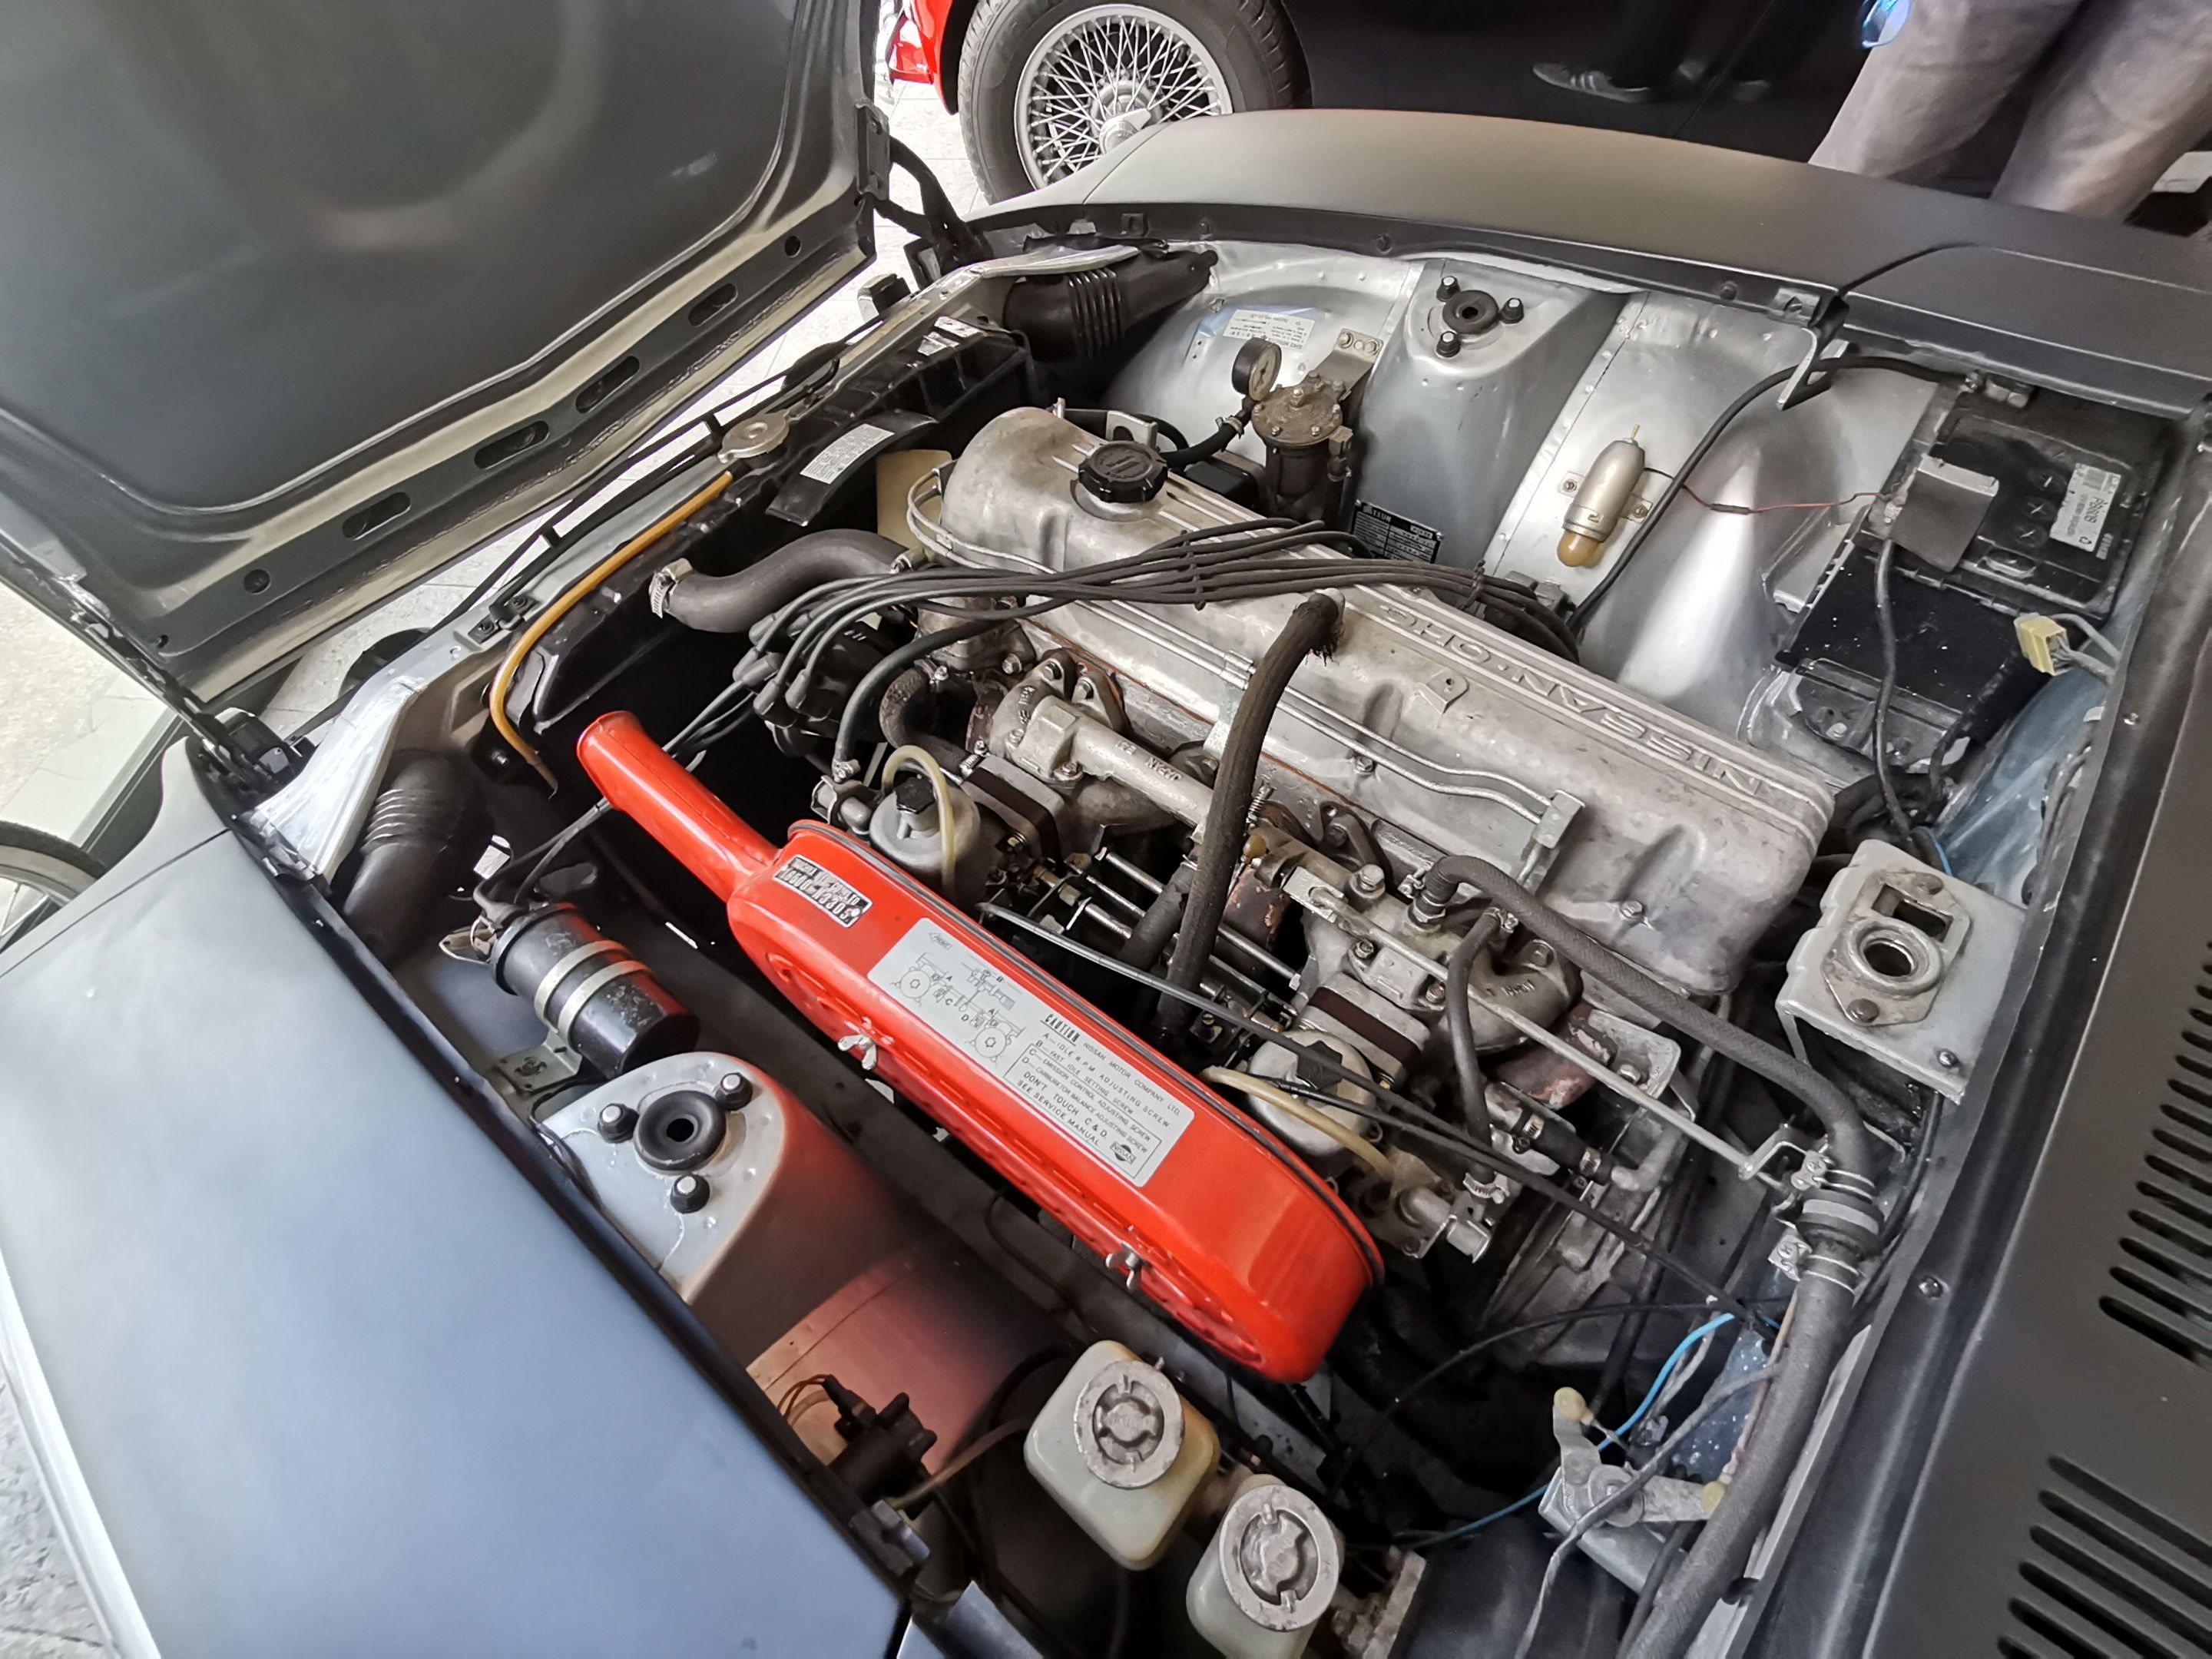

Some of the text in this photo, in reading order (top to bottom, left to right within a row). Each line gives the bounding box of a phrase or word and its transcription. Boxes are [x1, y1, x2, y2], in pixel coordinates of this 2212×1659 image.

[1510, 663, 1760, 797] NISSAN
[961, 1013, 969, 1022] D
[1044, 1013, 1080, 1042] CAUTION
[1022, 1071, 1047, 1091] DON'T
[1053, 1093, 1079, 1115] TOUCH
[1083, 1117, 1093, 1126] C
[1066, 1063, 1080, 1075] IDLE
[1084, 1076, 1109, 1096] SETTING
[1112, 1097, 1134, 1114] SCREW
[1082, 1042, 1106, 1060] NISSAN
[1108, 1061, 1131, 1078] MOTOR
[1133, 1079, 1164, 1103] COMPANY
[1016, 1079, 1101, 1145] SEE SERVICE MANUAL
[1069, 1078, 1096, 1099] CONTROL
[1097, 1098, 1130, 1125] ADJUSTING
[1129, 1123, 1151, 1141] SCREW
[1070, 1092, 1095, 1113] BALANCE
[1094, 1111, 1128, 1137] ADJUSTING
[1126, 1134, 1148, 1153] SCREW
[1098, 1073, 1141, 1107] ADJUSTING
[1142, 1105, 1170, 1128] SCREW
[1110, 1142, 1135, 1164] NISSAN
